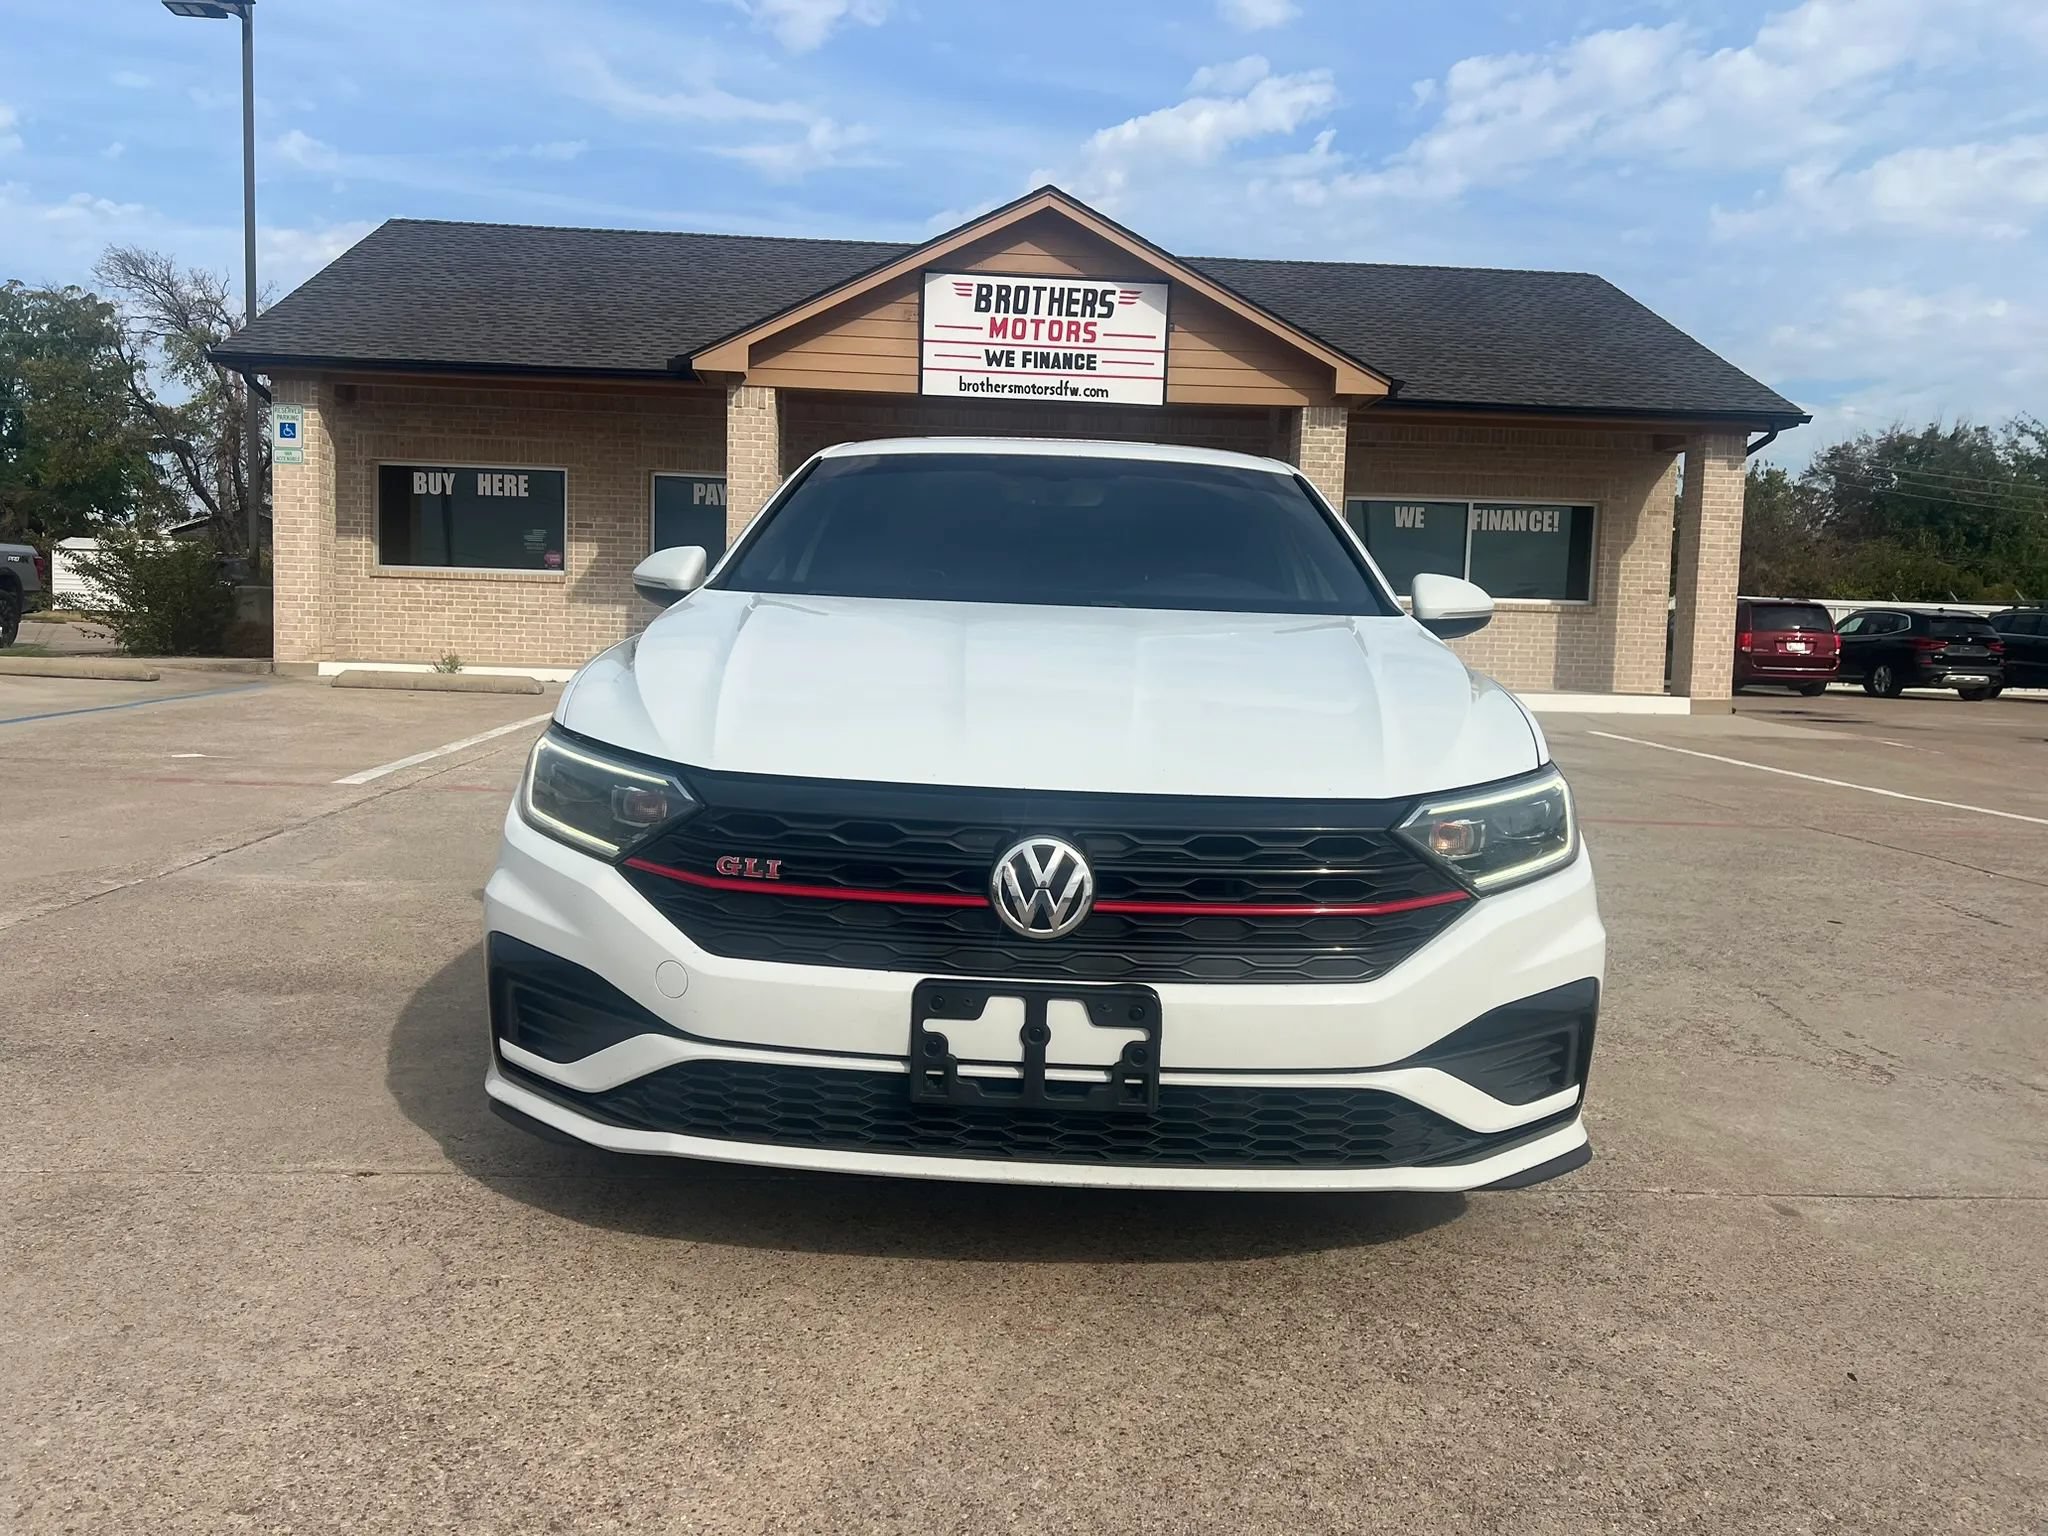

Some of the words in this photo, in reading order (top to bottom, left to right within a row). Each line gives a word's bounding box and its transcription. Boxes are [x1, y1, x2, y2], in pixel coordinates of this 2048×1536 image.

[974, 283, 1116, 318] BROTHERS
[989, 317, 1097, 343] MOTORS
[984, 349, 1015, 367] WE
[1021, 350, 1097, 370] FINANCE
[959, 376, 1109, 398] brothersmotorsdfw.com
[412, 471, 456, 496] BUY
[476, 473, 529, 497] HERE
[693, 482, 727, 505] PAY
[1394, 506, 1425, 529] WE
[1471, 509, 1560, 533] FINANCE!
[715, 855, 782, 879] GLI
